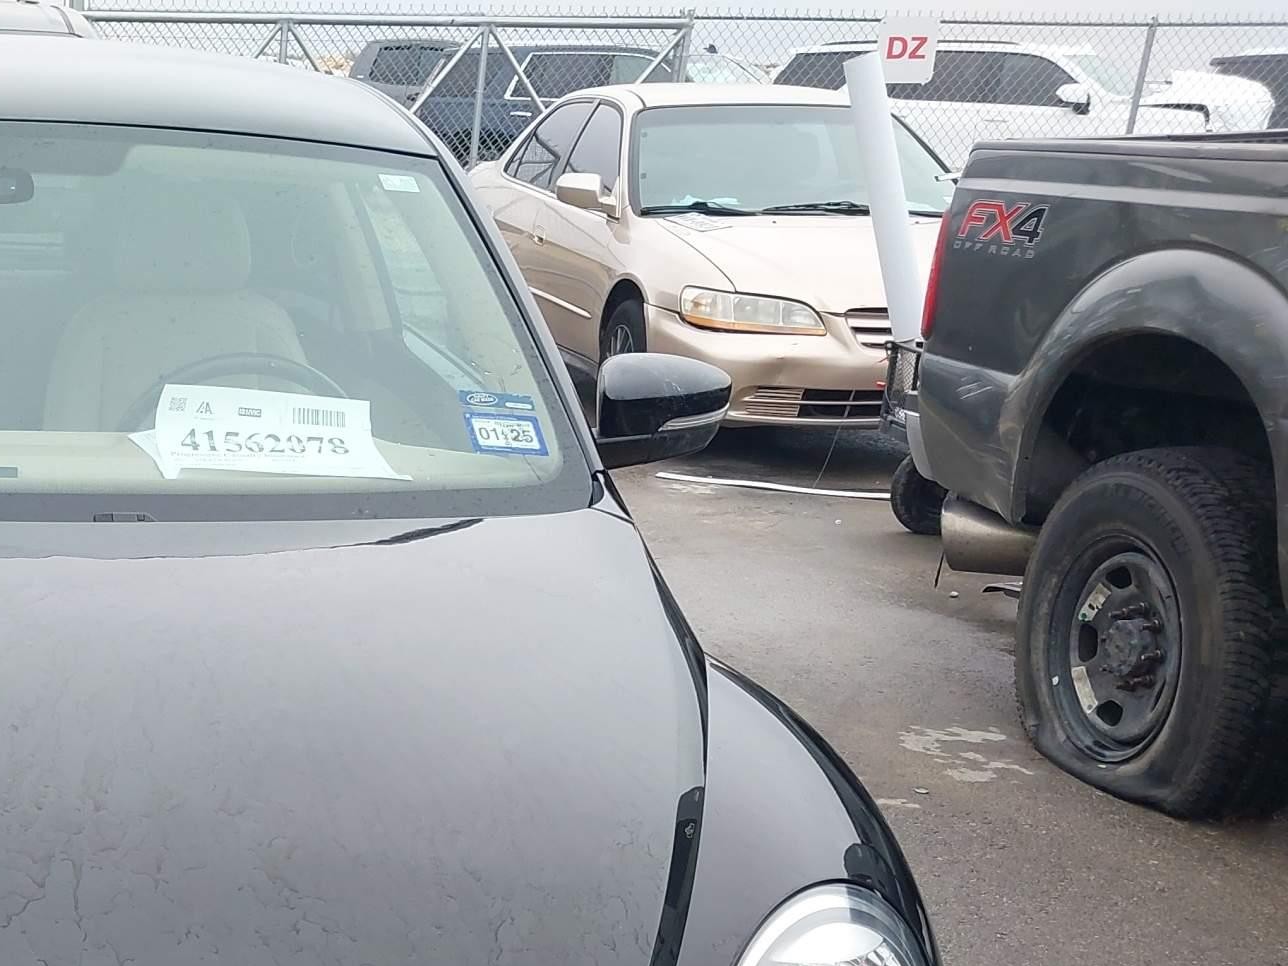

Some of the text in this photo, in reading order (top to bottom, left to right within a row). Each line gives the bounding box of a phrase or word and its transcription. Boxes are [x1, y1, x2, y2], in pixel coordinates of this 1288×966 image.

[885, 36, 929, 59] DZ
[956, 199, 1050, 247] FX4
[953, 240, 1035, 259] OFF ROAD
[181, 428, 350, 455] 41562078
[478, 427, 534, 444] 01 25
